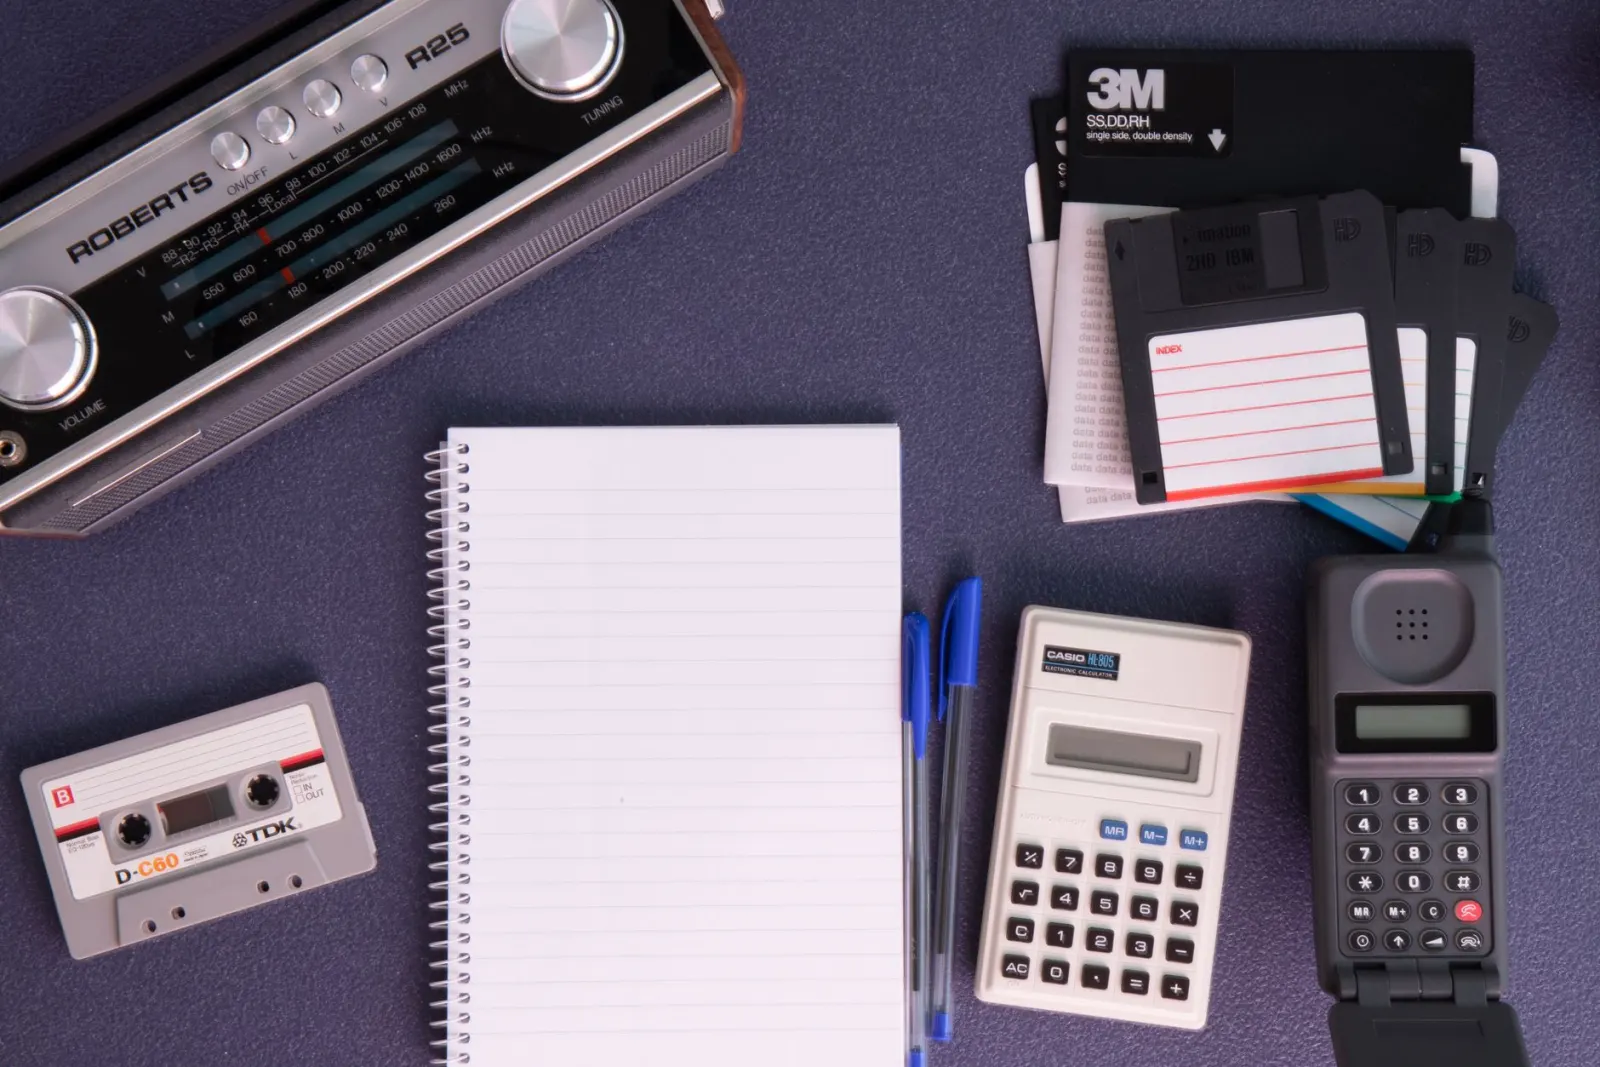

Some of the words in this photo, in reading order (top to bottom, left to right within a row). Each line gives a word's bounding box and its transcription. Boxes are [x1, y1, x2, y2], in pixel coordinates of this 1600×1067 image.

[404, 22, 471, 71] R25
[1087, 67, 1164, 109] 3M
[379, 97, 388, 107] V
[580, 95, 624, 127] TUNING
[333, 122, 345, 135] M
[1086, 131, 1110, 141] single
[1132, 132, 1161, 141] double
[1162, 132, 1193, 143] density
[288, 151, 298, 160] L
[137, 267, 147, 278] V
[162, 249, 178, 263] 88
[184, 236, 200, 250] 90
[207, 222, 224, 236] 92
[232, 209, 248, 222] 94
[257, 193, 274, 207] 96
[285, 177, 301, 191] 98
[307, 163, 327, 178] 100
[333, 148, 350, 165] 102
[359, 133, 378, 149] 104
[384, 118, 403, 134] 106
[408, 103, 427, 119] 108
[443, 78, 470, 99] MHz
[226, 166, 269, 196] ON/OFF
[65, 171, 214, 266] ROBERTS
[161, 310, 175, 325] M
[202, 282, 225, 300] 550
[232, 264, 256, 283] 600
[274, 240, 297, 257] 700
[301, 224, 325, 243] 800
[336, 201, 364, 222] 1000
[375, 179, 401, 199] 1200
[404, 162, 430, 183] 1400
[435, 143, 462, 164] 1600
[470, 125, 493, 144] kHz
[185, 350, 195, 360] L
[238, 311, 258, 327] 160
[287, 282, 308, 299] 180
[322, 261, 345, 279] 200
[353, 242, 376, 260] 220
[386, 222, 408, 242] 240
[433, 194, 456, 214] 260
[492, 161, 516, 179] kHz
[1225, 247, 1255, 267] IBM
[1083, 262, 1105, 271] data
[1082, 274, 1105, 283] data
[1081, 286, 1104, 295] data
[1081, 297, 1103, 307] data
[1080, 309, 1102, 319] data
[1079, 321, 1101, 330] data
[1079, 332, 1100, 342] data
[1078, 344, 1100, 354] data
[1155, 344, 1183, 355] INDEX
[1077, 356, 1099, 366] data
[1077, 368, 1098, 378] data
[1076, 380, 1097, 390] data
[1075, 391, 1096, 401] data
[1100, 393, 1121, 403] data
[58, 398, 107, 432] VOLUME
[1074, 403, 1096, 413] data
[1099, 405, 1121, 415] data
[1074, 415, 1095, 425] data
[1098, 417, 1120, 427] data
[1073, 427, 1094, 437] data
[1097, 429, 1119, 438] data
[1072, 439, 1093, 449] data
[1097, 441, 1118, 450] data
[1071, 451, 1093, 460] data
[1096, 452, 1117, 462] data
[1071, 463, 1092, 472] data
[1095, 464, 1117, 474] data
[1087, 494, 1107, 504] data
[1111, 491, 1132, 502] data
[1047, 650, 1085, 663] CASIO
[1045, 664, 1077, 674] ELECTRONIC
[1078, 669, 1113, 678] CALCULATOR
[302, 782, 313, 792] IN
[56, 788, 70, 805] B
[305, 787, 325, 802] OUT
[1359, 789, 1368, 801] 1
[1408, 788, 1418, 801] 2
[1456, 788, 1467, 801] 3
[245, 816, 296, 845] TDK
[1358, 818, 1369, 831] 4
[1408, 817, 1418, 830] 5
[1456, 817, 1467, 830] 6
[1104, 825, 1125, 837] MR
[1184, 835, 1204, 846] M+
[1359, 847, 1370, 859] 7
[1409, 846, 1419, 859] 8
[1457, 846, 1467, 859] 9
[114, 853, 180, 885] D-C60
[1065, 857, 1076, 867] 7
[1104, 862, 1116, 873] 8
[1144, 867, 1156, 878] 9
[1408, 875, 1419, 888] 0
[1060, 892, 1071, 903] 4
[1100, 898, 1111, 909] 5
[1139, 903, 1151, 914] 6
[1354, 907, 1369, 917] MR
[1389, 906, 1406, 917] M+
[1429, 906, 1438, 916] C
[1015, 925, 1027, 936] C
[1057, 930, 1064, 941] 1
[1095, 935, 1107, 946] 2
[1135, 941, 1147, 952] 3
[1006, 962, 1028, 974] AC
[1050, 967, 1062, 977] 0
